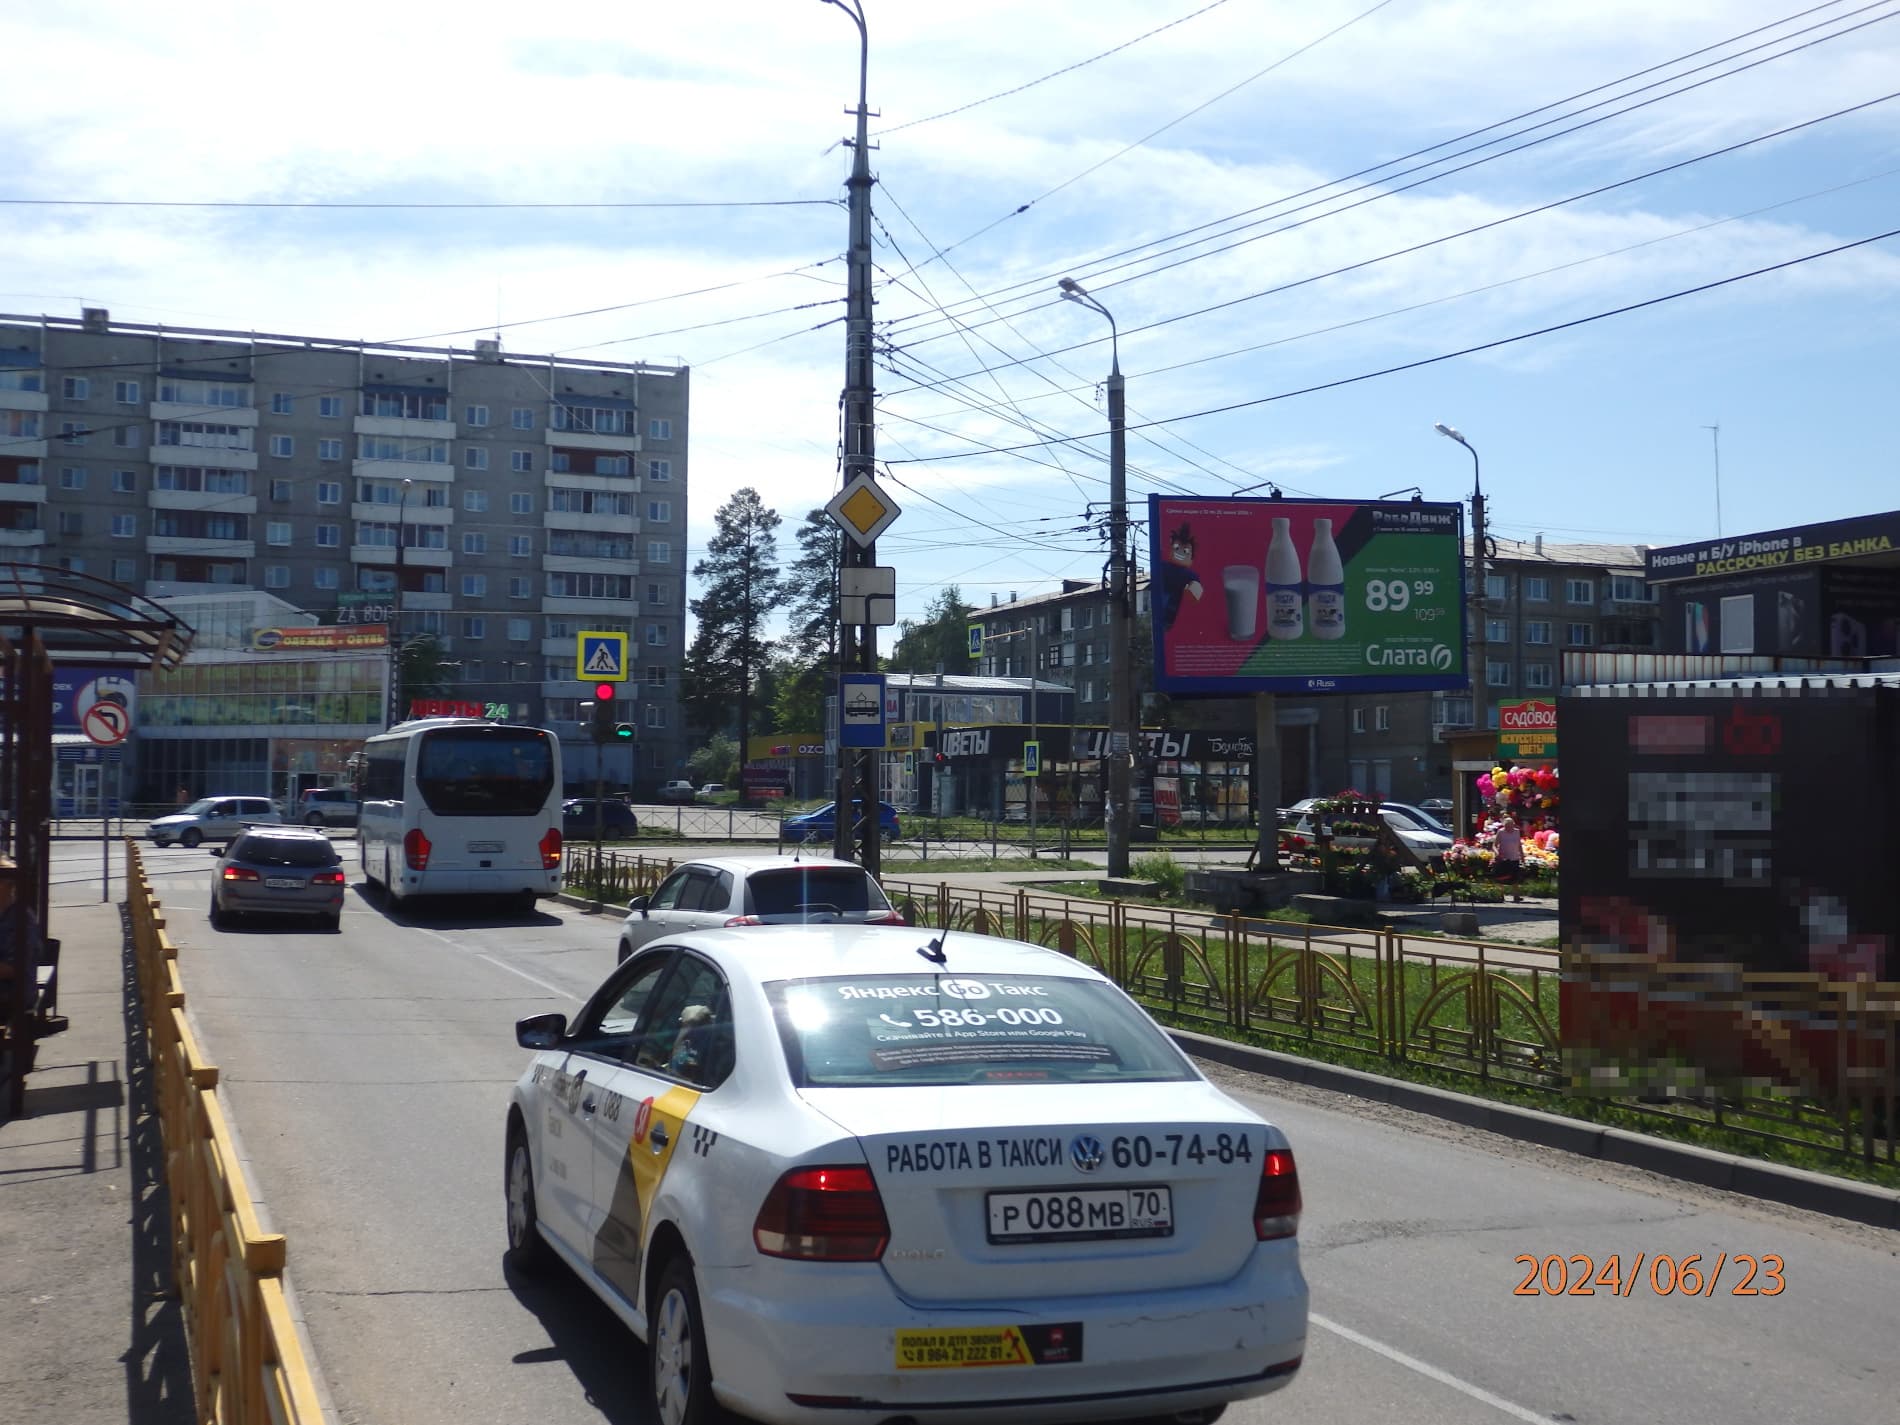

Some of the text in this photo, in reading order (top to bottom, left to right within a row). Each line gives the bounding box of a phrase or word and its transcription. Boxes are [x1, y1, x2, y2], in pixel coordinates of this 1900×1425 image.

[1652, 536, 1803, 568] Новые и Б/У iPhone в
[1695, 536, 1893, 576] РАССРОЧКУ БЕЗ БАНКА
[1365, 579, 1410, 611] 89
[1414, 580, 1434, 595] 99
[1366, 643, 1428, 666] Слата
[485, 702, 509, 719] 24
[942, 729, 991, 759] ЦВЕТЫ
[838, 984, 940, 1000] Яндекс
[913, 1007, 1063, 1027] 586-000
[887, 1133, 1253, 1173] РАБОТА В ТАКСИ 60-74-84
[1132, 1191, 1161, 1217] 70
